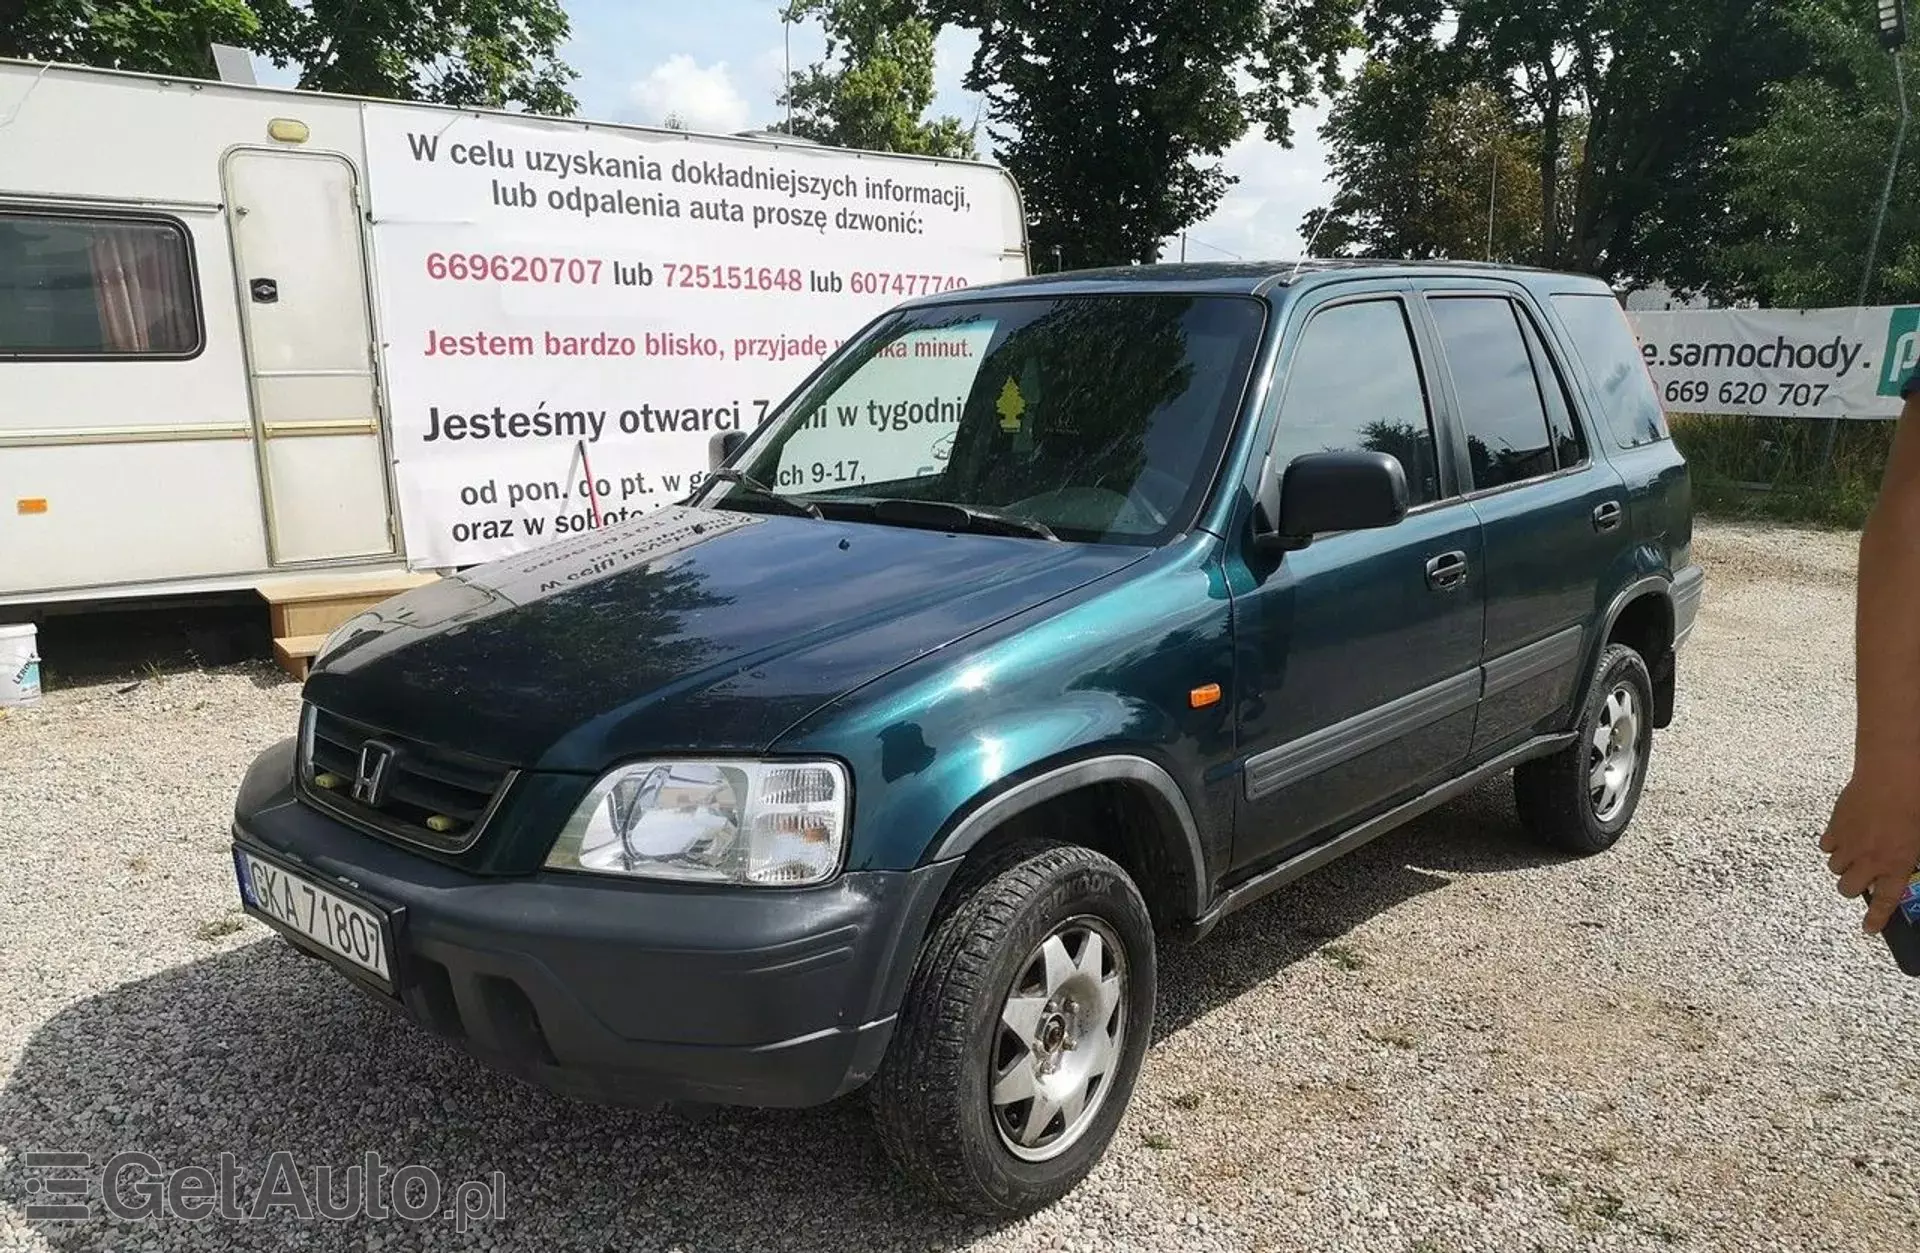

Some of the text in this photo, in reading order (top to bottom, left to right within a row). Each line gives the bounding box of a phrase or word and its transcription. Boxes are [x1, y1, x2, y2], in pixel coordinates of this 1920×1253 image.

[407, 133, 971, 213] W celu uzyskania dokładniejszych informacji,
[491, 179, 924, 235] lub odpalenia auta proszę dzwonić:
[426, 252, 603, 285] 669620707
[613, 261, 653, 286] lub
[662, 263, 803, 293] 725151648
[810, 270, 843, 293] lub
[424, 330, 534, 357] Jestem
[545, 331, 636, 356] bardzo
[645, 332, 725, 360] blisko,
[734, 334, 827, 362] przyjadę
[915, 336, 973, 358] minut.
[1665, 380, 1829, 406] 669 620 707
[423, 401, 606, 443] Jesteśmy
[619, 400, 740, 434] otwarci
[753, 400, 769, 426] 7
[837, 406, 858, 428] w
[866, 396, 963, 432] tygodni
[460, 479, 497, 506] od
[507, 479, 569, 508] pon.
[578, 477, 612, 498] do
[620, 472, 654, 501] pt.
[661, 472, 681, 492] w
[811, 460, 866, 484] 9-17,
[452, 517, 515, 543] oraz
[523, 515, 545, 536] w
[250, 861, 380, 969] GKA 71807
